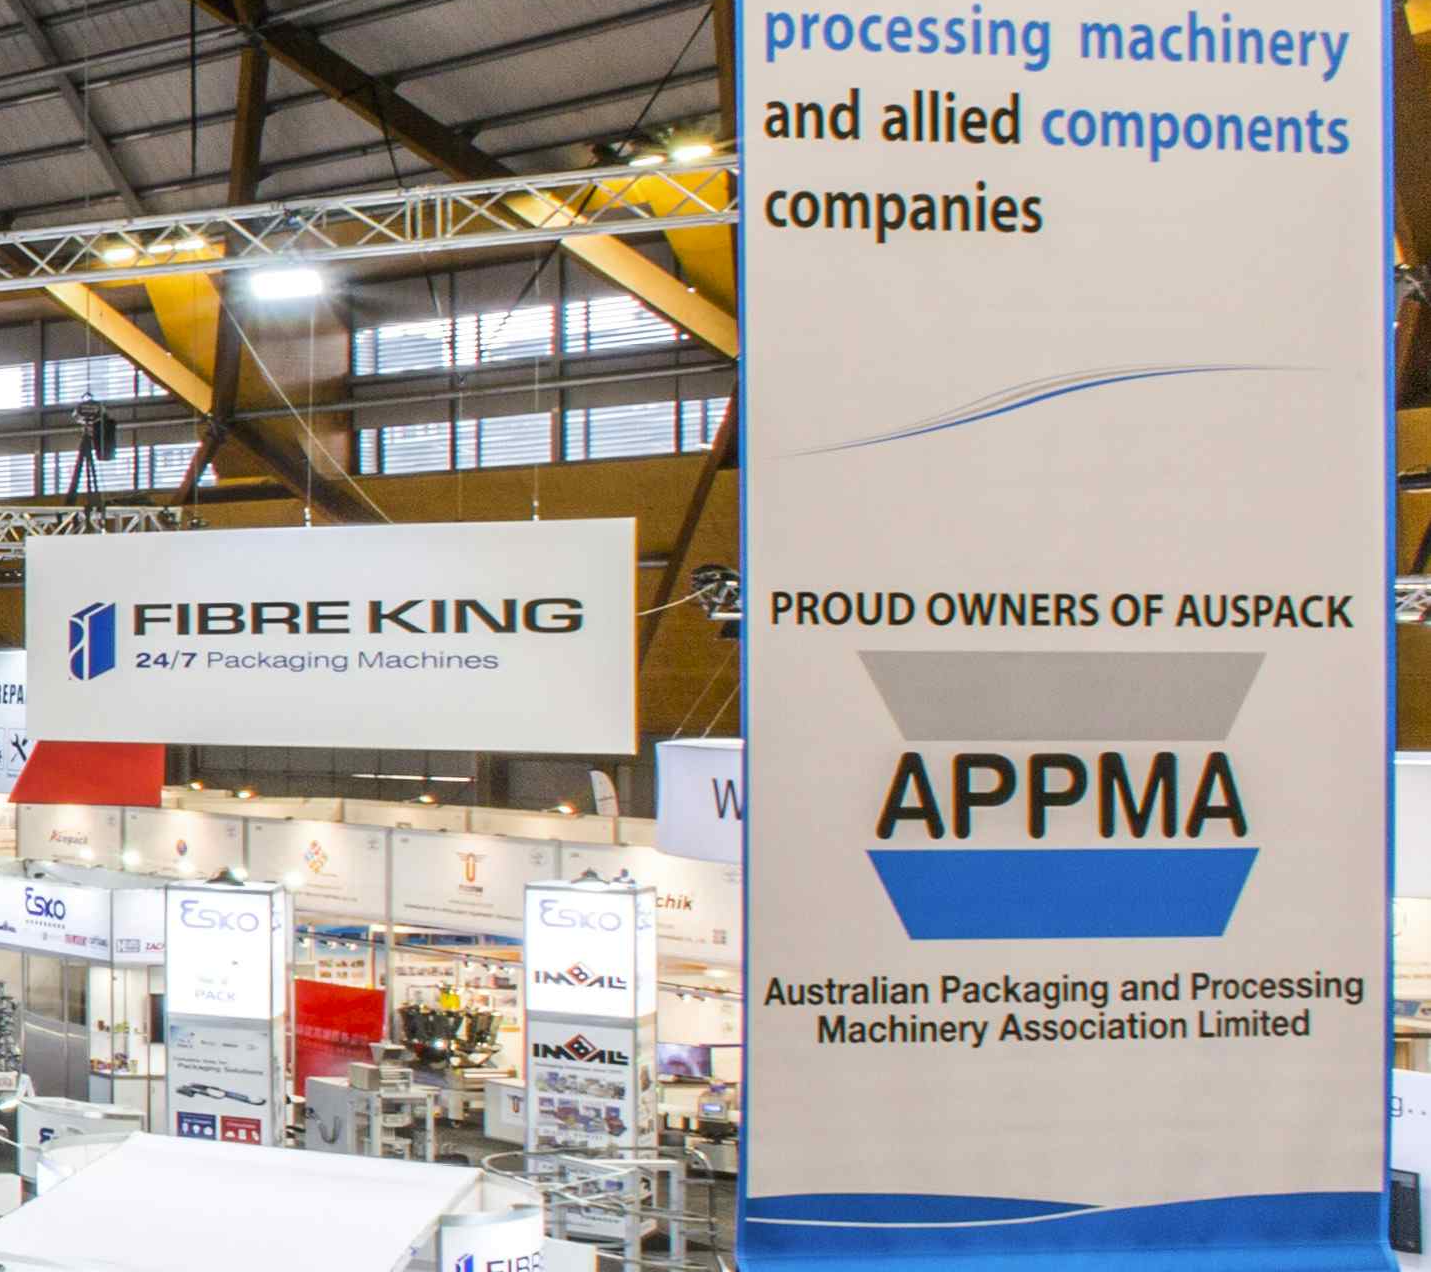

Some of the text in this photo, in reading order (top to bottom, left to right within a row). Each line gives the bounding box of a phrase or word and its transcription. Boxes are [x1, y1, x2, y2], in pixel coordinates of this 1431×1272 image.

[765, 5, 1349, 81] processing machinery
[765, 89, 1349, 162] and allied components
[765, 182, 1043, 243] companies
[134, 597, 583, 637] FIBRE KING
[771, 592, 1354, 629] PROUD OWNERS OF AUSPACK
[136, 649, 499, 673] 24/7 Packaging Machines
[875, 751, 1248, 840] APPMA
[764, 971, 1364, 1010] Australian Packaging and Processing
[818, 1009, 1310, 1047] Machinery Association Limited
